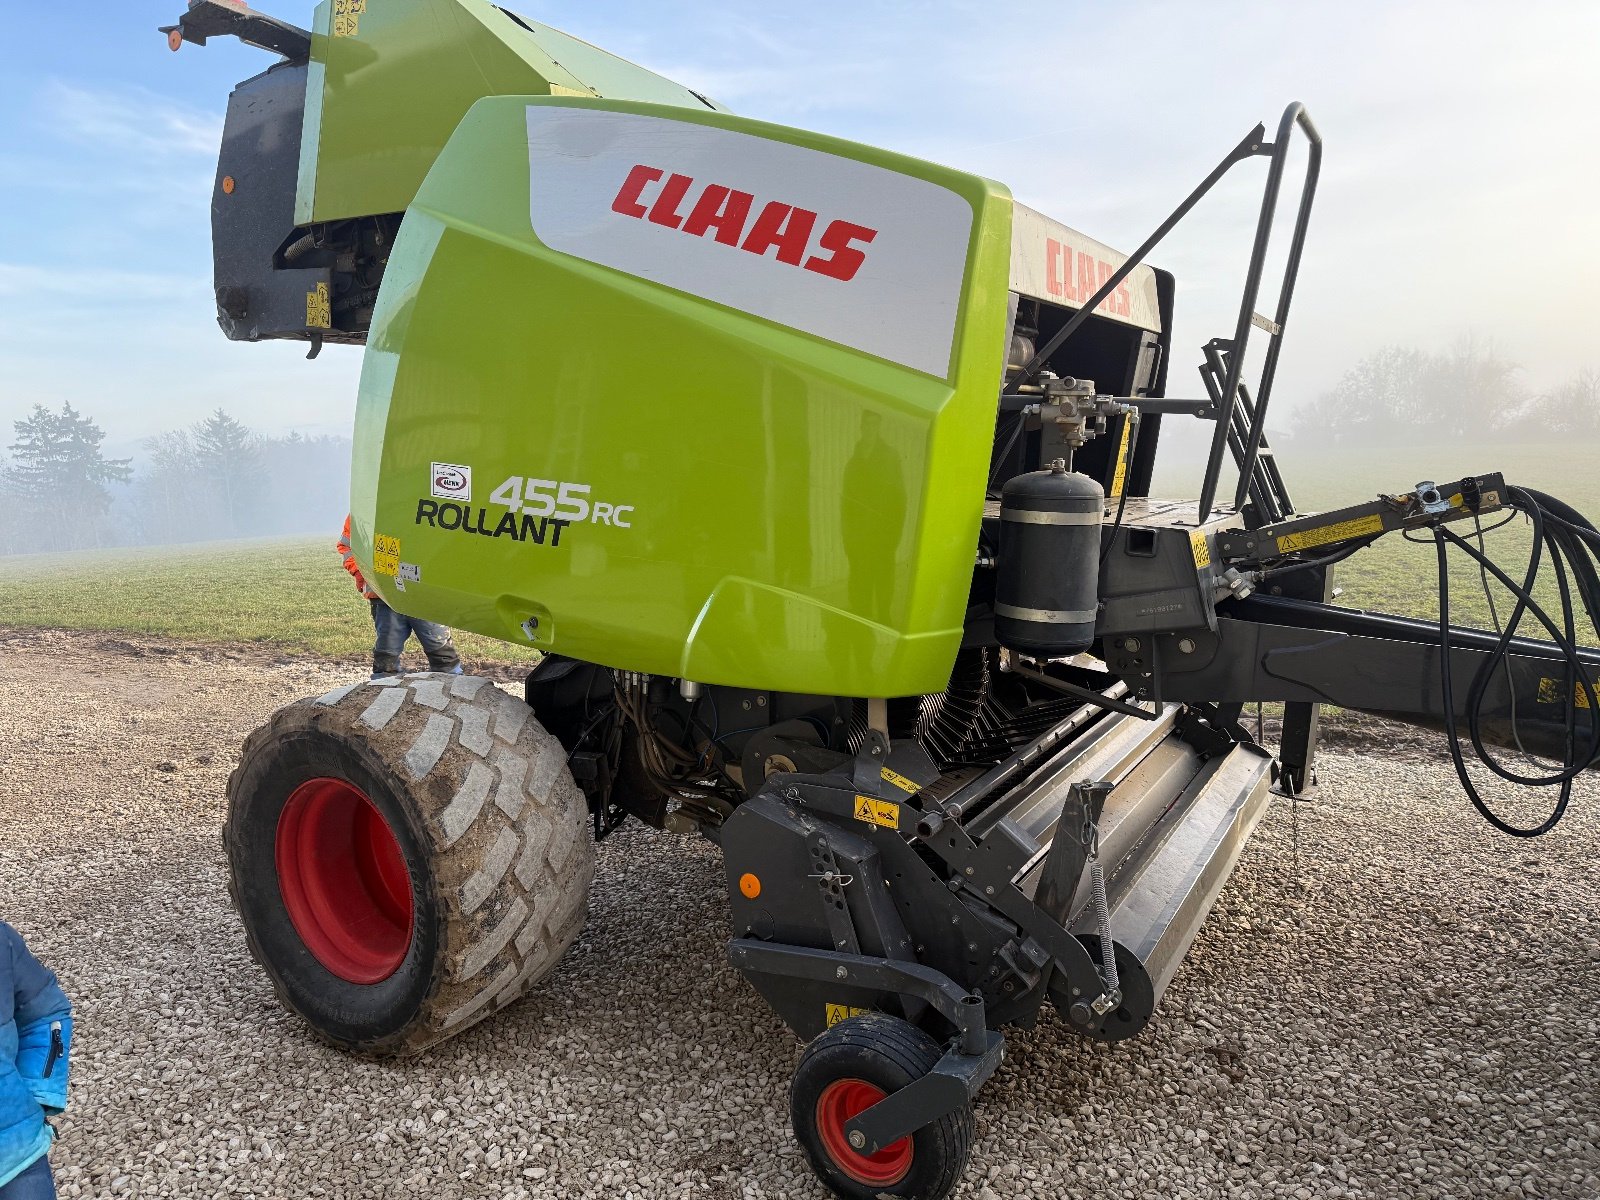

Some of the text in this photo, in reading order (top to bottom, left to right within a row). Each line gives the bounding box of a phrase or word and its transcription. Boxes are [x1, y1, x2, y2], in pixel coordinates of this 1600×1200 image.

[611, 164, 878, 282] CLAAS
[415, 498, 570, 547] ROLLANT
[489, 475, 635, 528] 455 RC
